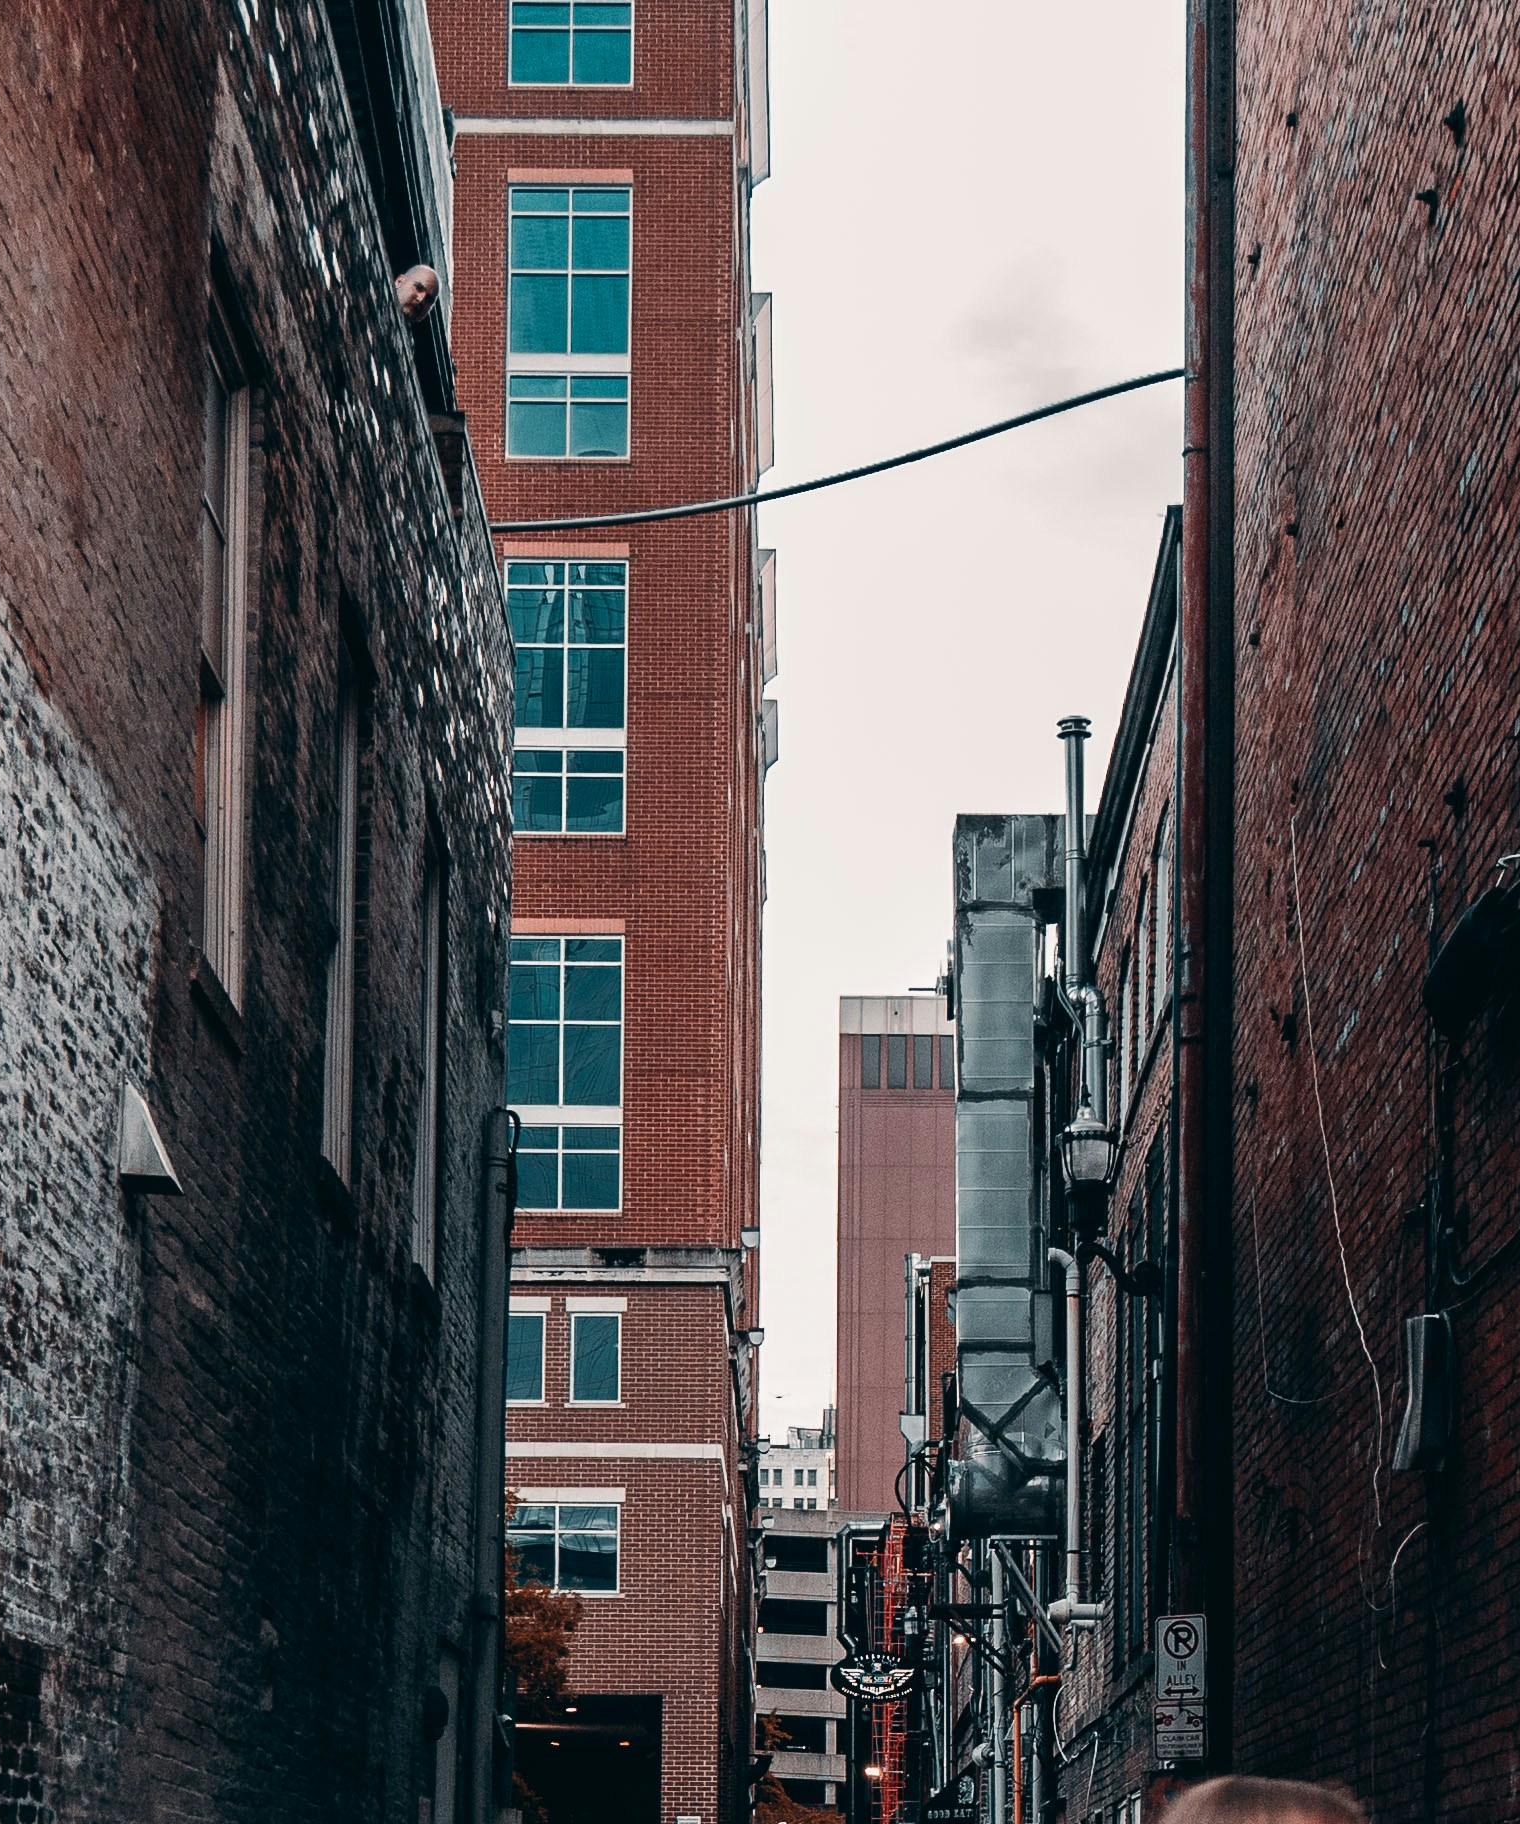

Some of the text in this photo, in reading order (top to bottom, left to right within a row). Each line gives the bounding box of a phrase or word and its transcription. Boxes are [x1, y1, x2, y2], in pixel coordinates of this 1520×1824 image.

[1176, 1660, 1187, 1672] IN
[1166, 1674, 1197, 1686] ALLEY
[927, 1808, 974, 1819] GOOD EAT
